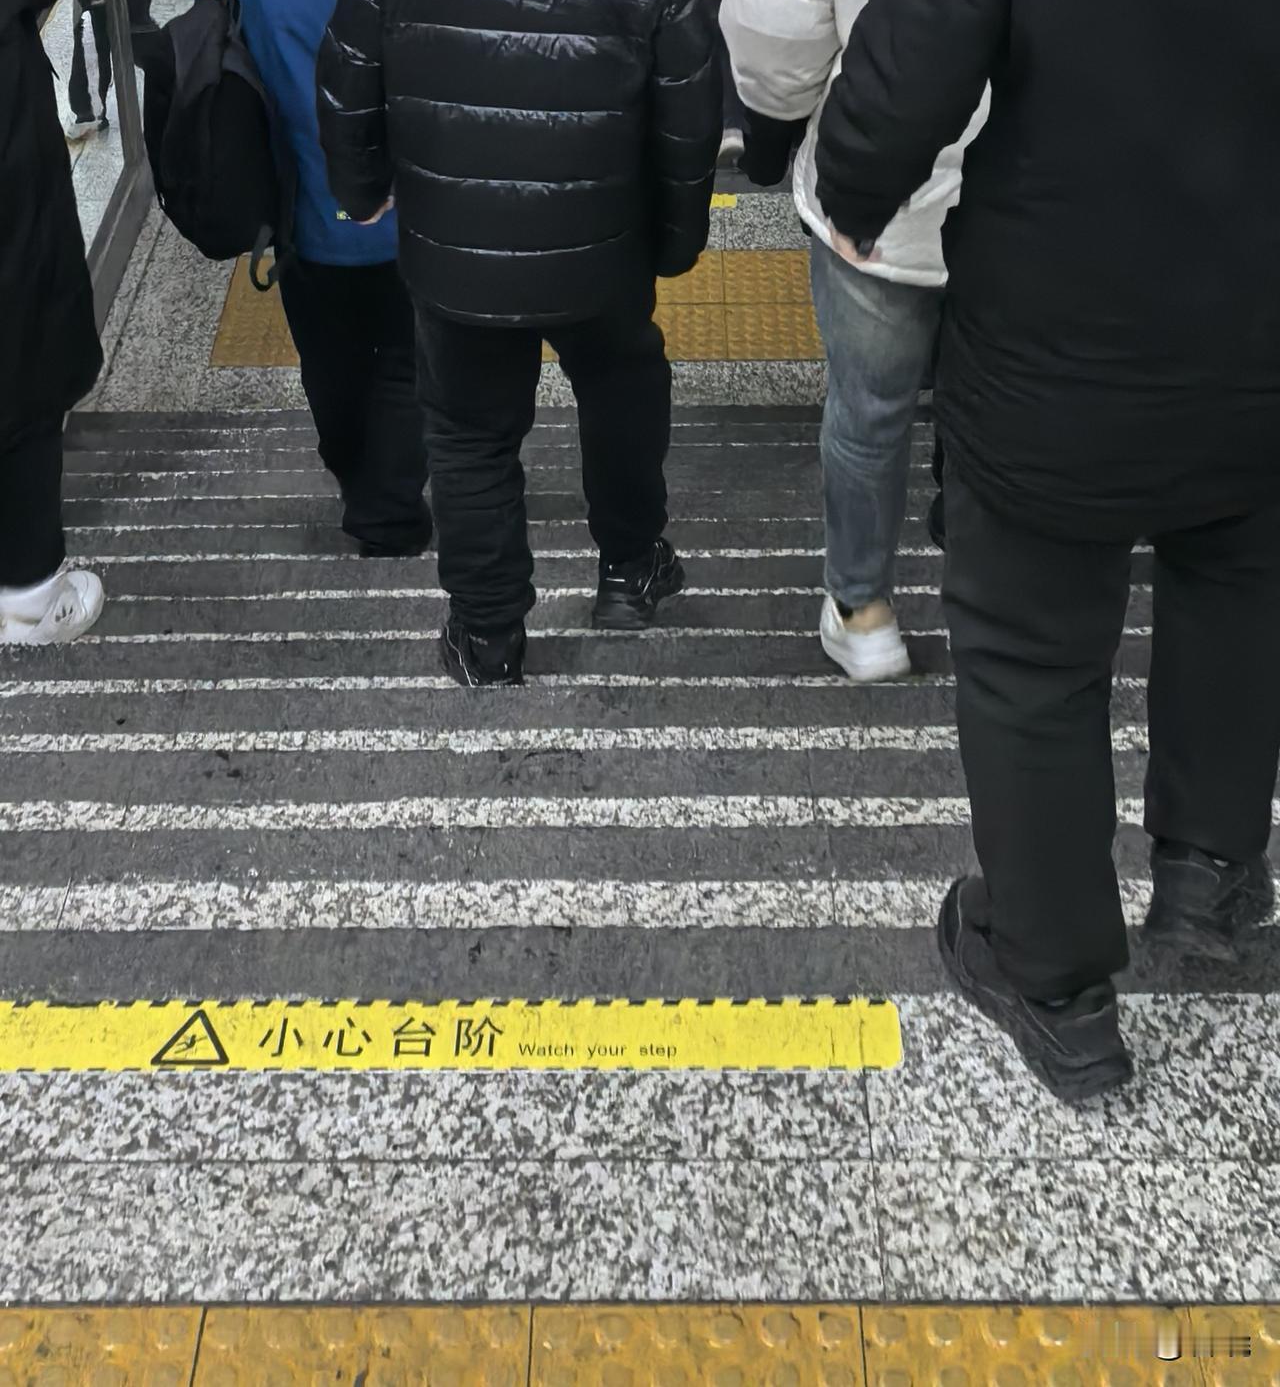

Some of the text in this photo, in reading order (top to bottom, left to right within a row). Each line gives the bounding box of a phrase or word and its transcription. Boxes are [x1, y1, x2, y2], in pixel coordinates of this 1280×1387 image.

[258, 1016, 504, 1058] 小心台阶
[518, 1042, 678, 1060] Watch your step
